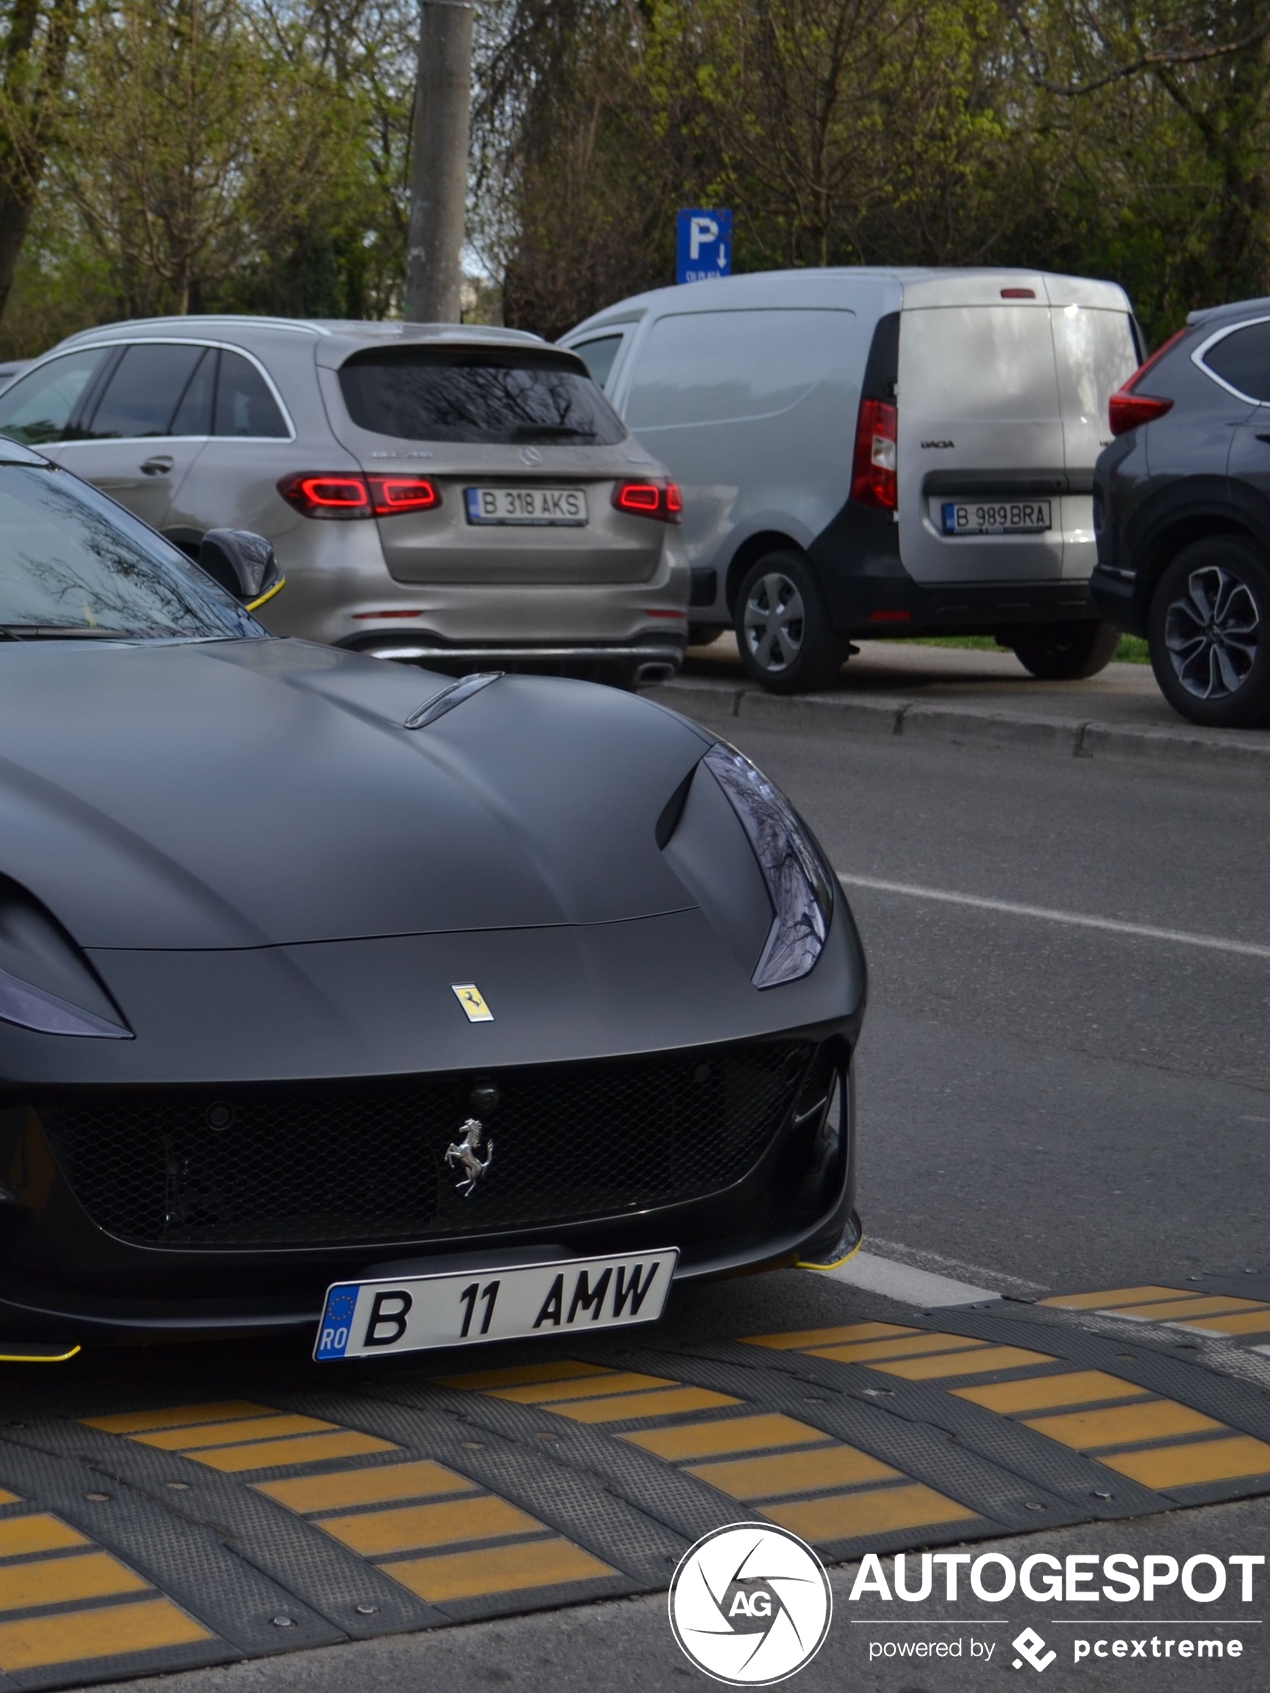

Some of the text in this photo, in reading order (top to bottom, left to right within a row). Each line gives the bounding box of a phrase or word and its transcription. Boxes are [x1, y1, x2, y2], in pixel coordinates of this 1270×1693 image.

[690, 217, 718, 259] P
[920, 439, 955, 449] DACIA
[482, 492, 498, 514] B
[504, 493, 535, 514] 318
[540, 493, 580, 516] AKS
[956, 504, 1046, 527] B 989 BRA
[363, 1262, 660, 1347] B 11 AMW
[319, 1327, 348, 1350] RO
